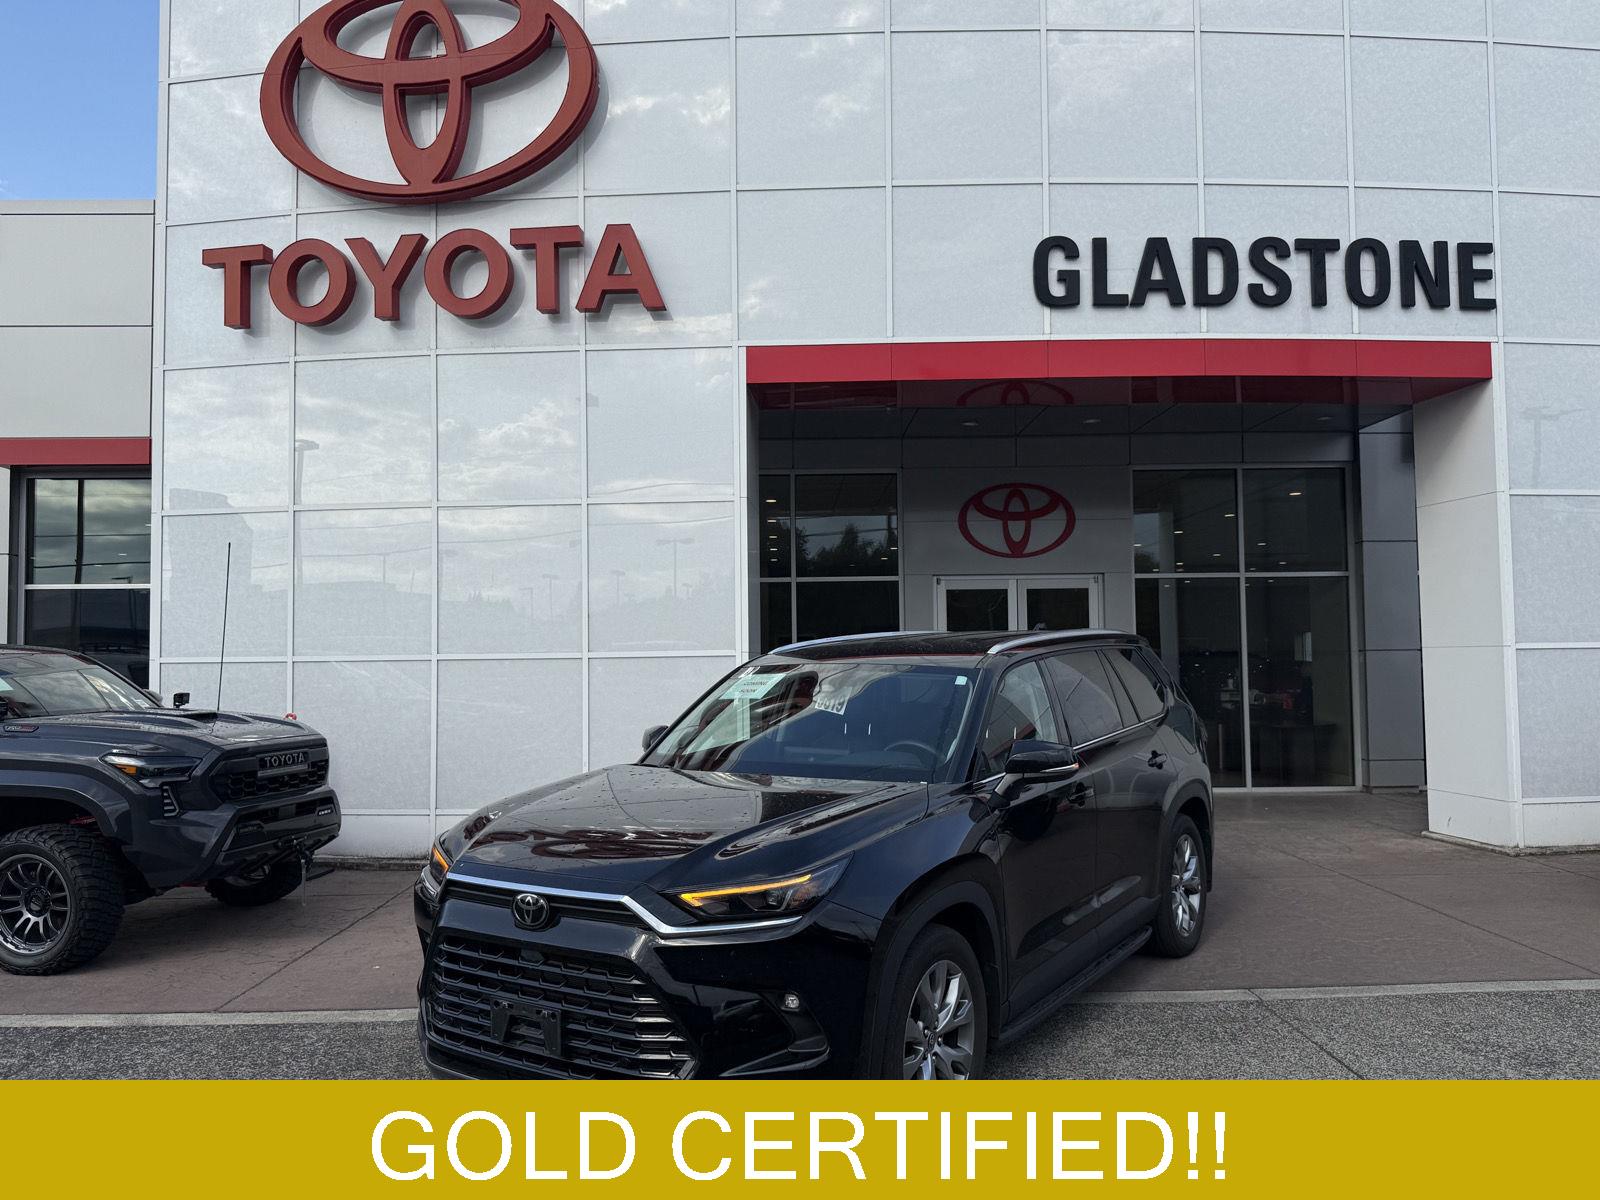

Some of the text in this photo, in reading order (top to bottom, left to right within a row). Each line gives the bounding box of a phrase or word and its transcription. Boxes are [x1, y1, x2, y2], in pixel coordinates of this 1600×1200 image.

[201, 222, 668, 330] TOYOTA
[1033, 236, 1496, 310] GLADSTONE
[264, 752, 305, 769] TOYOTA
